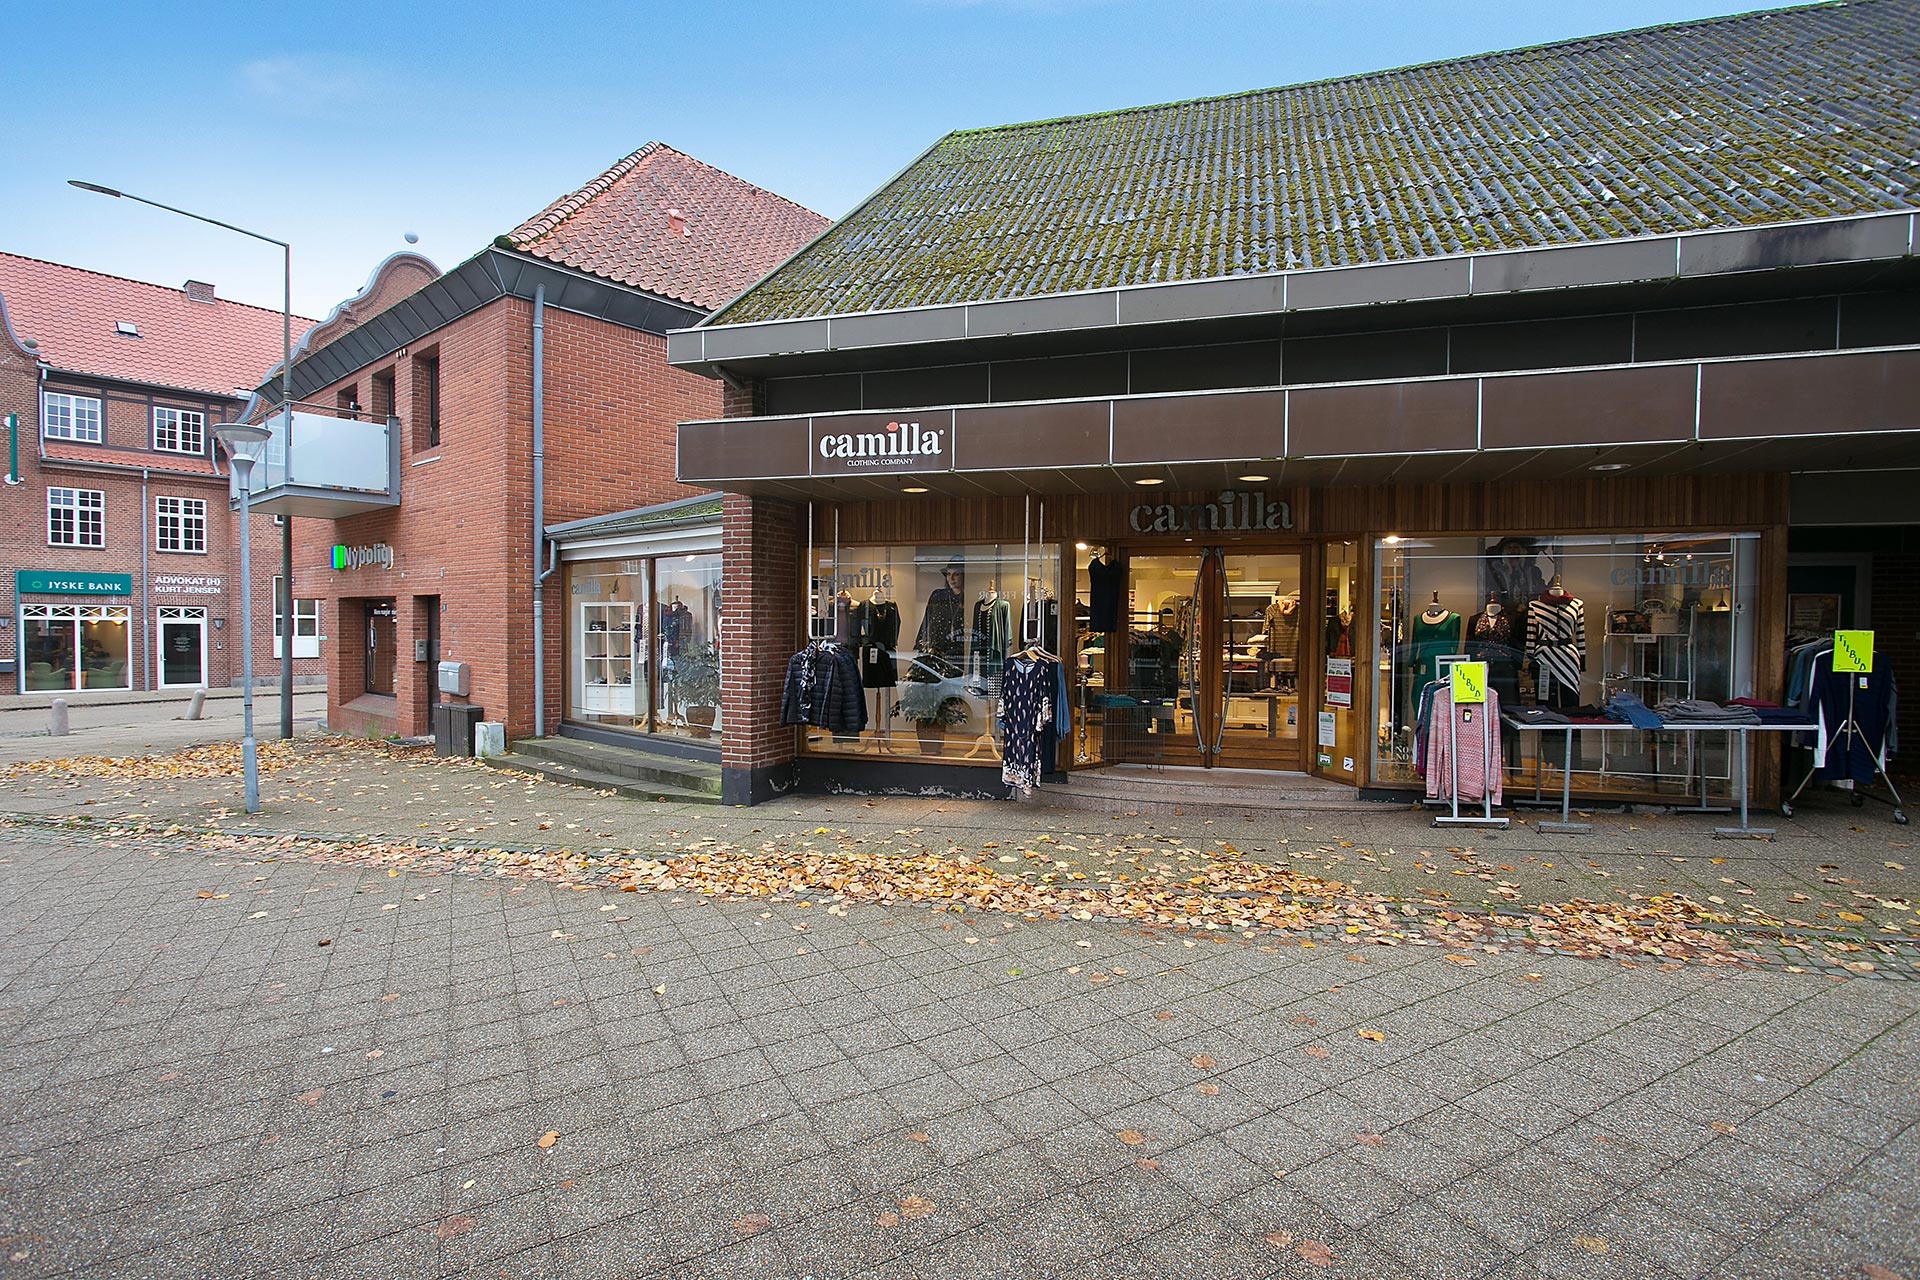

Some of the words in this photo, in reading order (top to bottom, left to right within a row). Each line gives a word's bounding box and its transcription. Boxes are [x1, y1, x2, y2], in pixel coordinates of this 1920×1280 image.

[819, 421, 943, 458] camilla
[847, 459, 880, 467] CLOTHING
[880, 458, 914, 466] COMPANY
[1129, 490, 1294, 533] camilla
[344, 543, 393, 570] Nybolig
[155, 576, 205, 585] ADVOKAT
[206, 577, 221, 586] (H)
[1609, 559, 1731, 586] camilla
[48, 581, 85, 590] JYSKE
[88, 582, 122, 591] BANK
[155, 585, 182, 594] KURT
[182, 586, 221, 595] JENSEN
